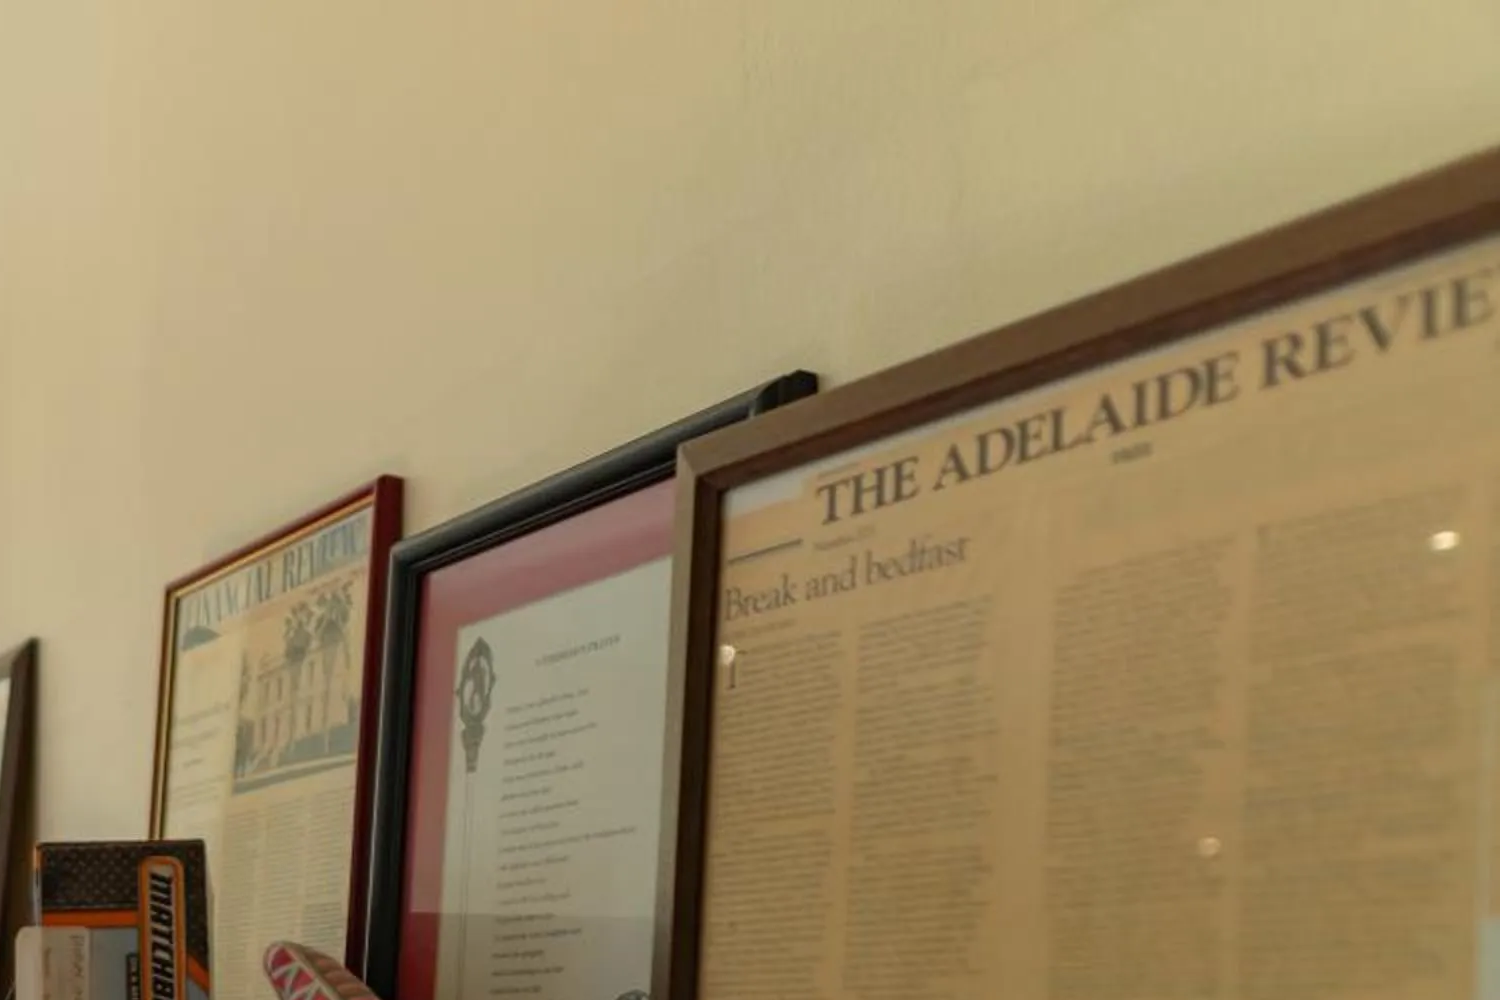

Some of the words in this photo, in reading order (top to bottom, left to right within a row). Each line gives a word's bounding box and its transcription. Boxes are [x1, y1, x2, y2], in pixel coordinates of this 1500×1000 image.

[815, 455, 920, 526] THE
[931, 351, 1241, 493] ADELAIDE
[1257, 264, 1500, 391] REVIE
[724, 572, 798, 622] Break
[805, 554, 858, 601] and
[865, 534, 971, 586] bedfast
